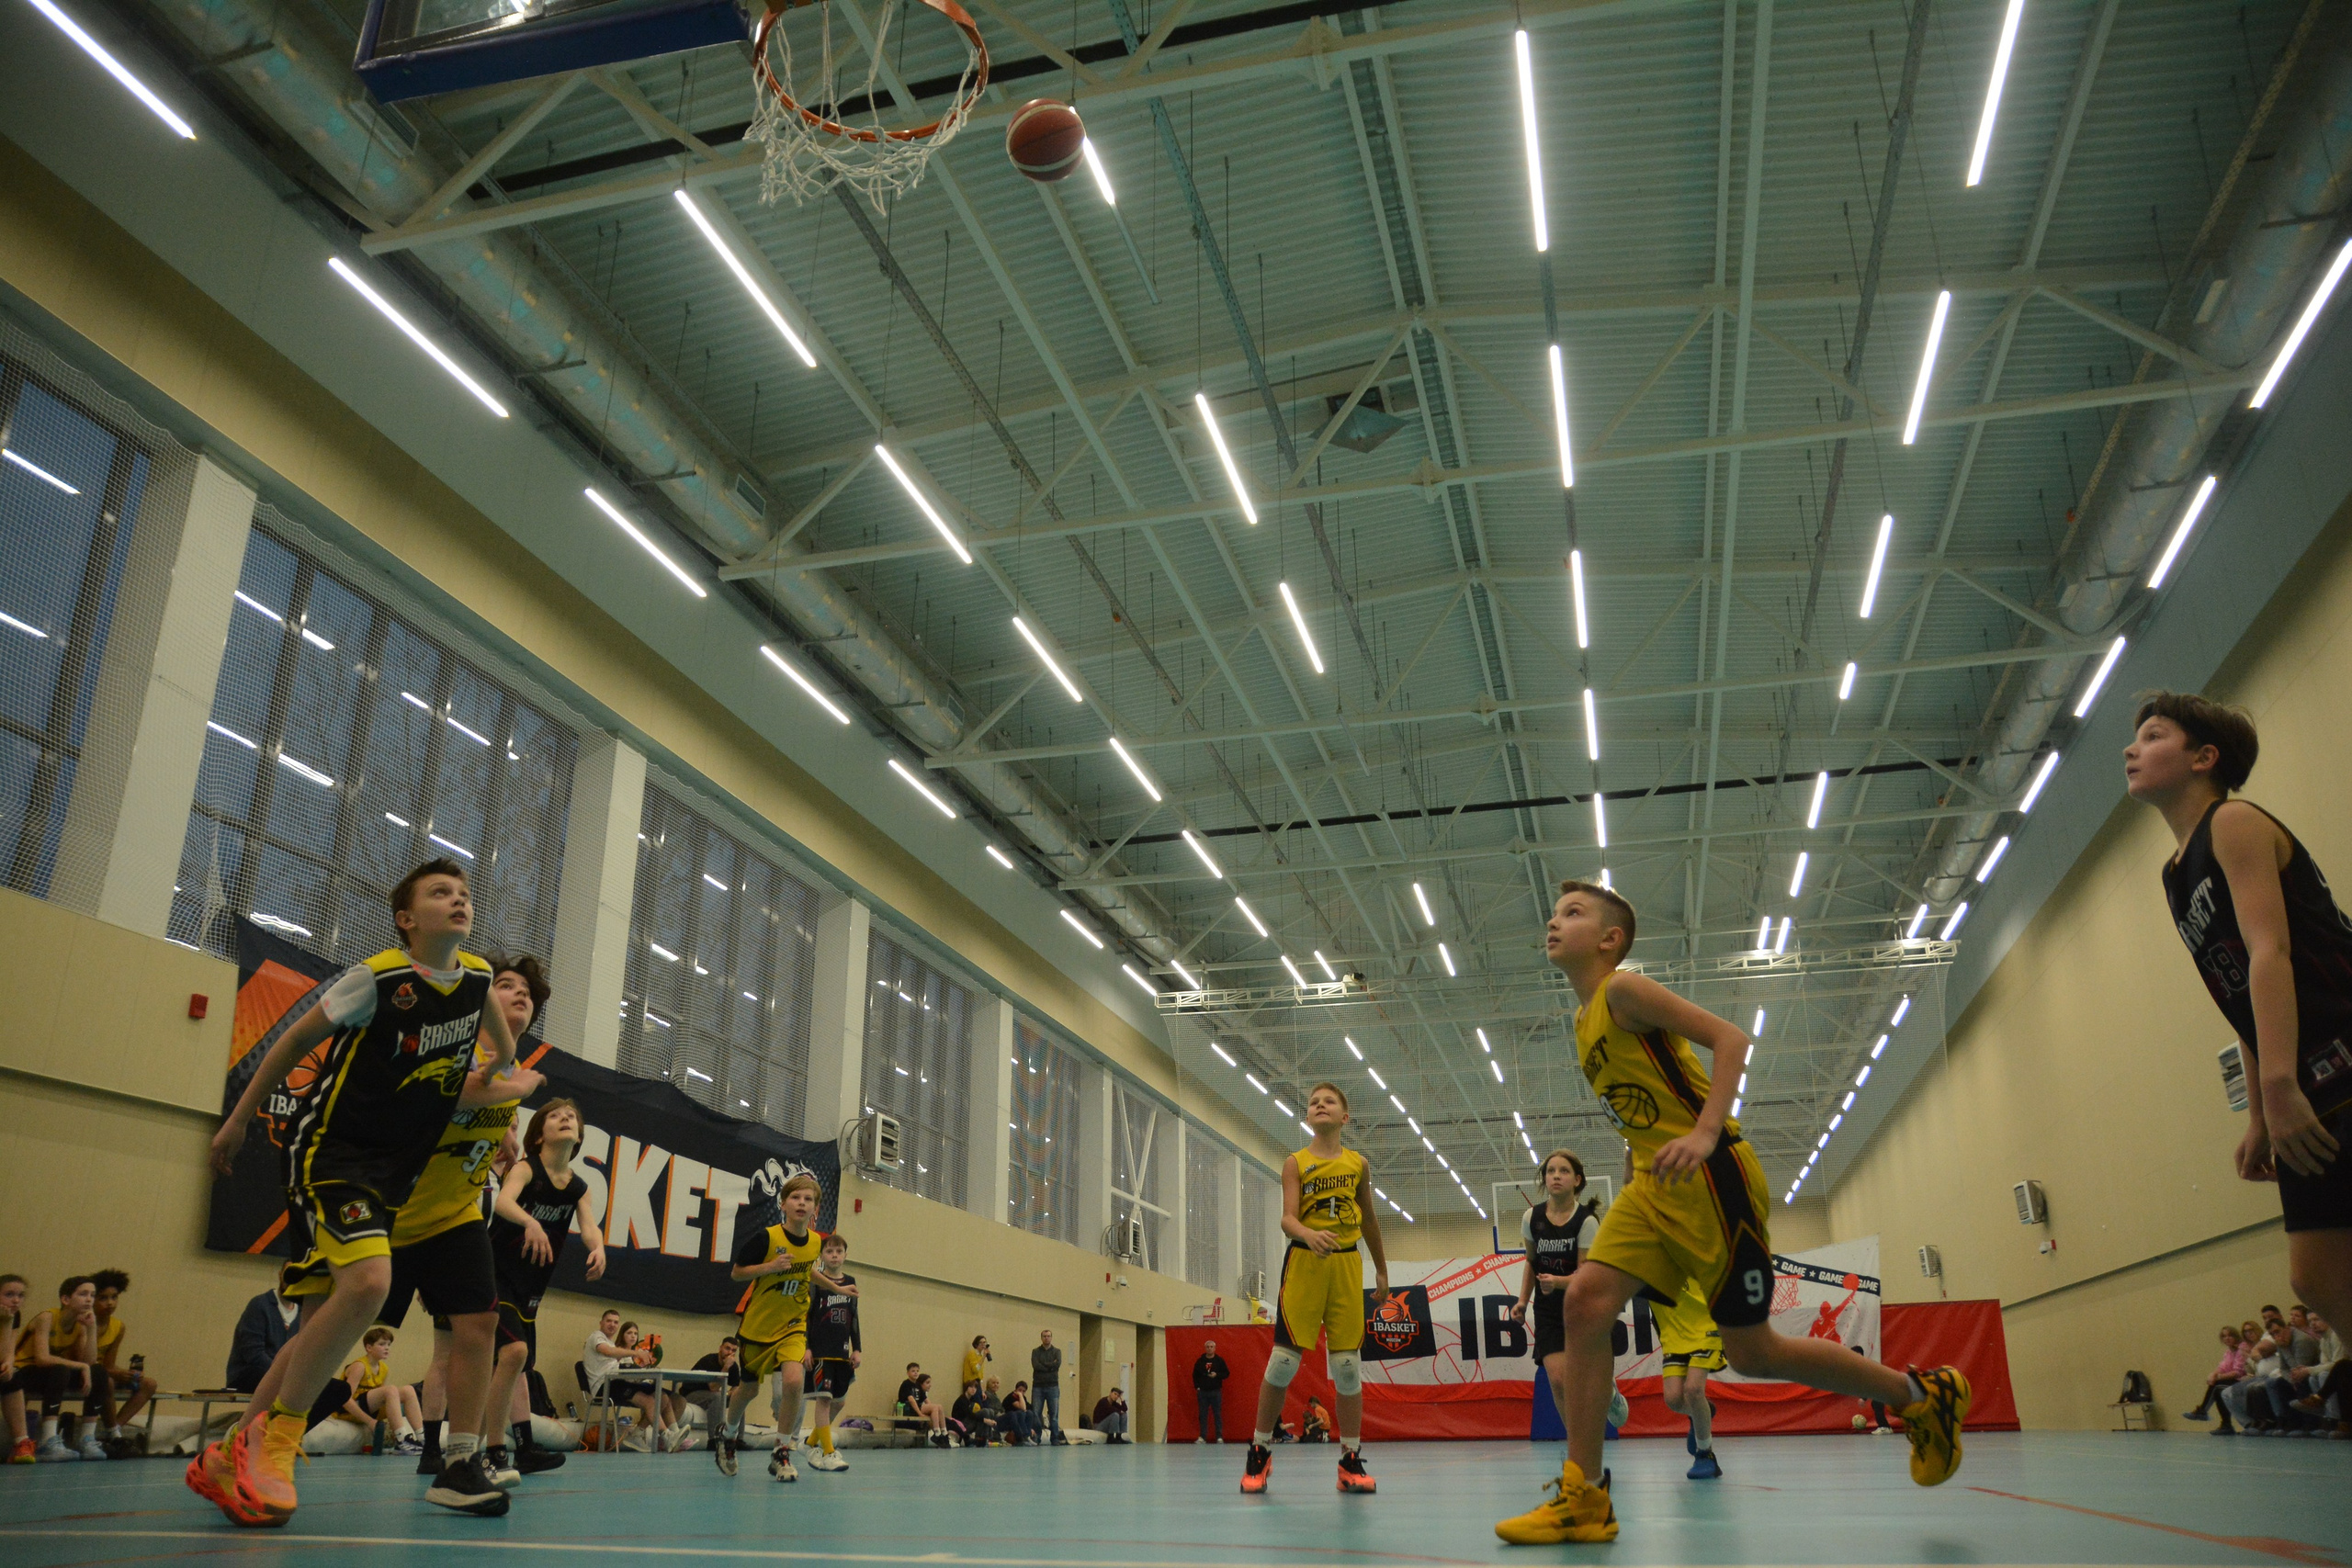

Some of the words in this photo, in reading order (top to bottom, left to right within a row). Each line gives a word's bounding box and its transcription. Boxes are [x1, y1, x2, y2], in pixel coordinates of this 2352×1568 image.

[2178, 876, 2216, 954] ASKET
[462, 1139, 491, 1173] 9
[1329, 1196, 1337, 1218] 1
[1536, 1237, 1576, 1255] BASKET
[1428, 1271, 1475, 1299] CHAMPIONS
[1781, 1261, 1807, 1277] GAME
[1818, 1270, 1845, 1286] GAME
[781, 1280, 799, 1296] 10
[1743, 1269, 1765, 1304] 9
[1374, 1322, 1416, 1333] IBASKET
